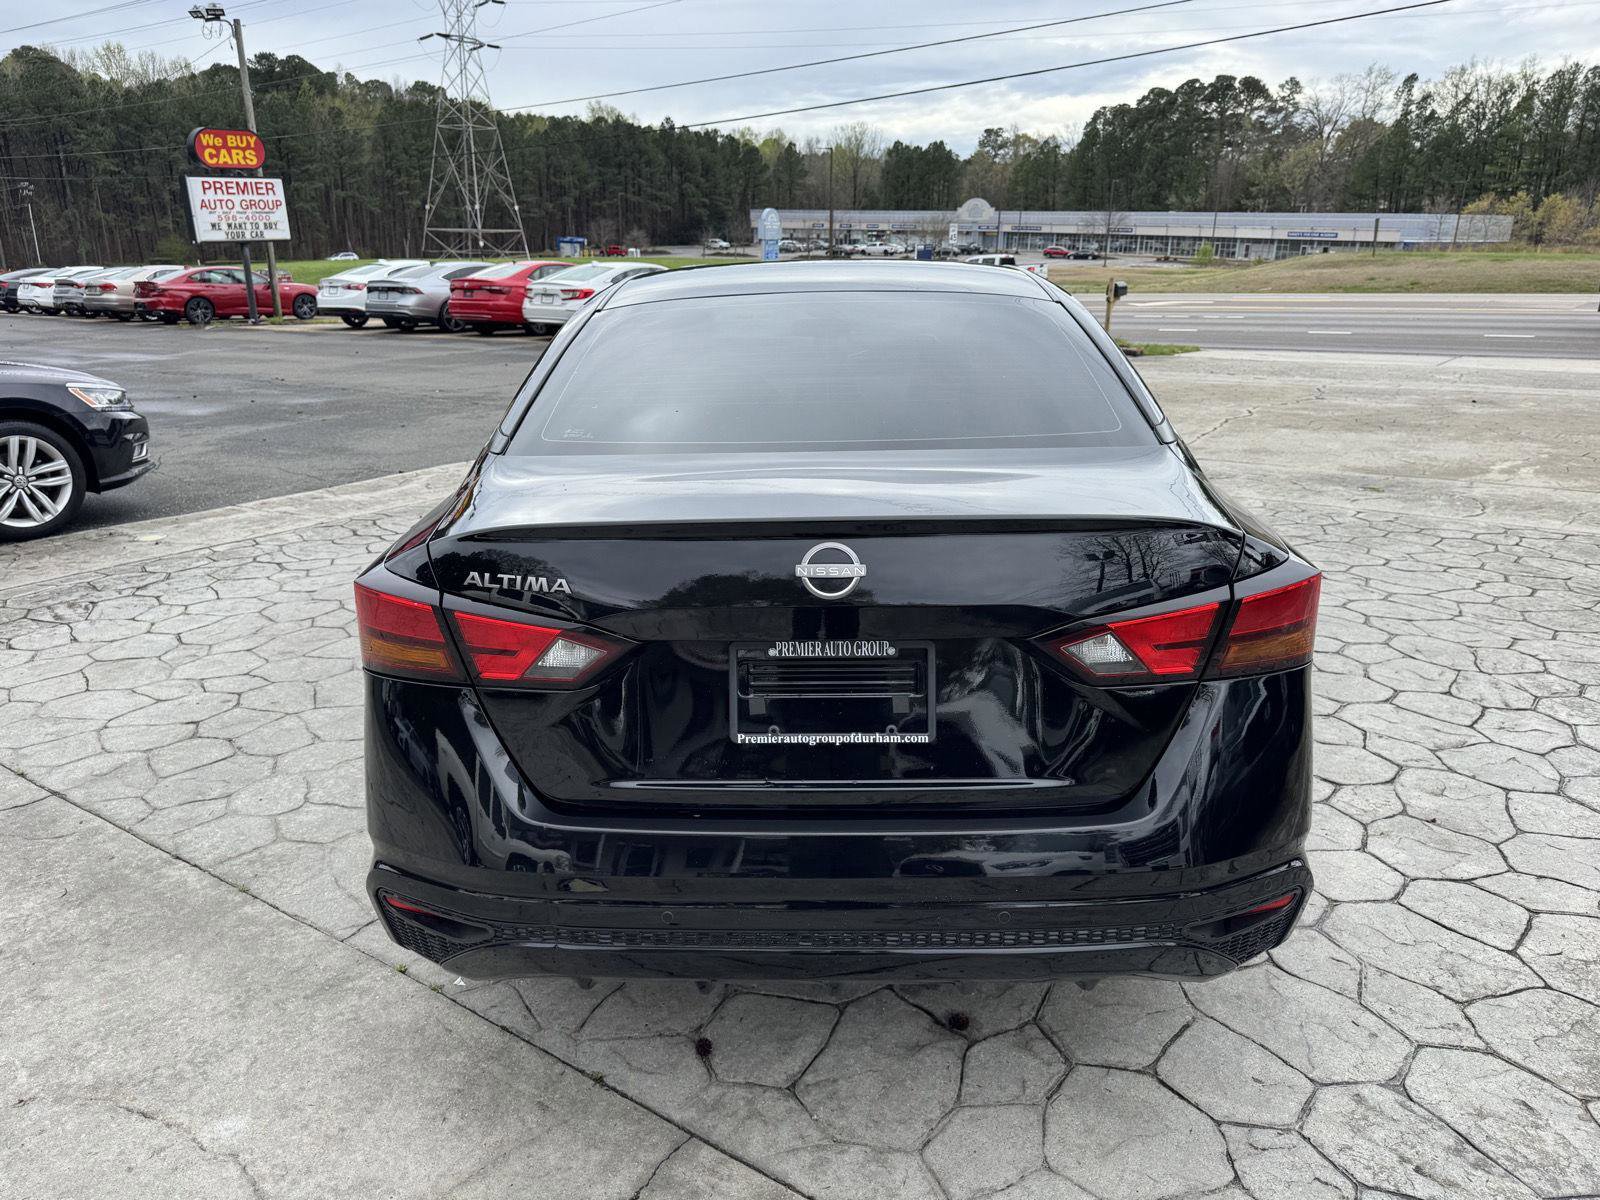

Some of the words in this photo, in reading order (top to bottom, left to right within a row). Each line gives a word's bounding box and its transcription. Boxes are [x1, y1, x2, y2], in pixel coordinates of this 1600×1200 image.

[200, 133, 223, 146] We
[227, 135, 257, 147] BUY
[204, 148, 258, 165] CARS
[201, 180, 276, 195] PREMIER
[200, 199, 235, 210] AUTO
[240, 199, 282, 210] GROUP
[210, 222, 222, 230] WE
[227, 222, 247, 230] WANT
[250, 222, 260, 230] TO
[264, 222, 278, 230] BUY
[225, 231, 246, 239] YOUR
[250, 231, 265, 239] CAR
[797, 567, 865, 576] NISSAN
[463, 571, 572, 594] ALTIMA
[775, 641, 822, 657] PREMIER
[824, 641, 850, 656] AUTO
[853, 641, 889, 656] GROUP
[737, 733, 929, 746] Premierautogroupofdurham.com
